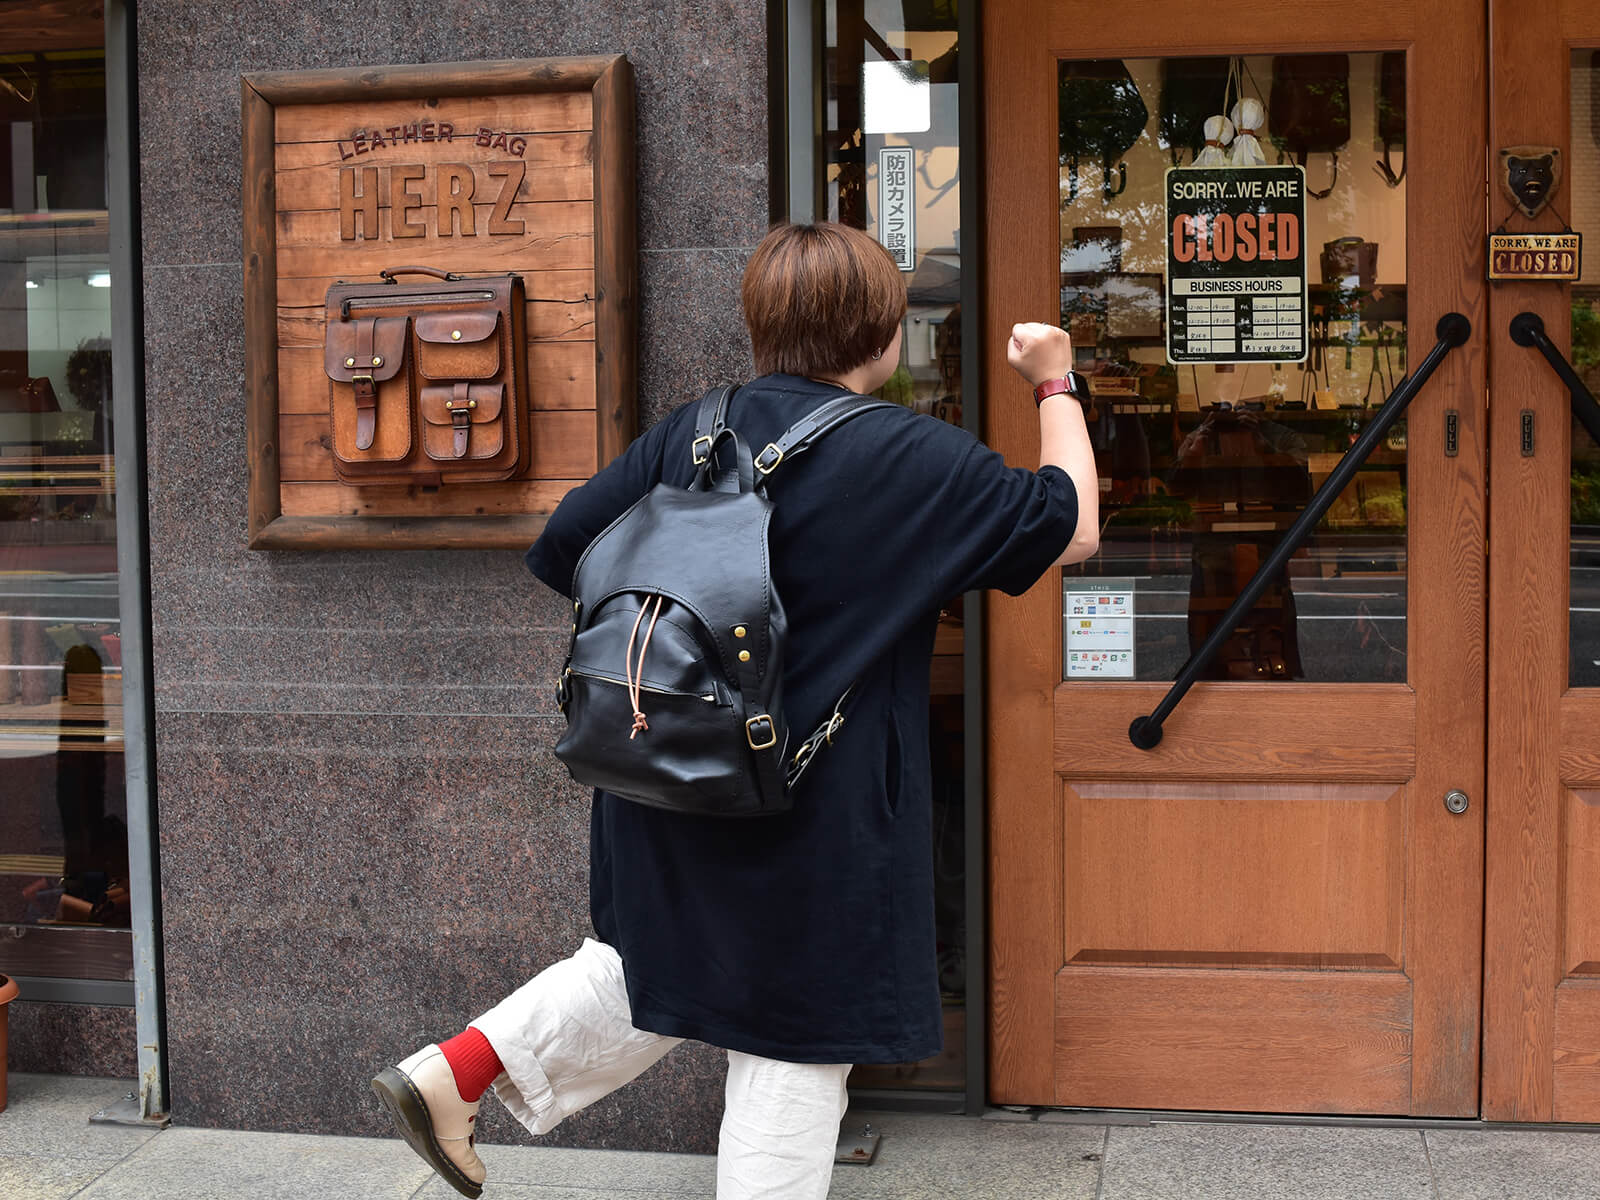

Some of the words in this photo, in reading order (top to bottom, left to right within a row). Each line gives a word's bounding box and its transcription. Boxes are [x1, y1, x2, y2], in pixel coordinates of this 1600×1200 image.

[338, 123, 454, 160] LEATHER
[476, 127, 527, 158] BAG
[1265, 180, 1298, 198] ARE
[340, 160, 526, 240] HERZ
[1173, 213, 1299, 262] CLOSED
[1494, 239, 1532, 249] SORRY,
[1534, 239, 1551, 248] WE
[1555, 239, 1576, 248] ARE
[1496, 253, 1572, 272] CLOSED
[1190, 281, 1243, 292] BUSINESS
[1245, 280, 1283, 291] HOURS
